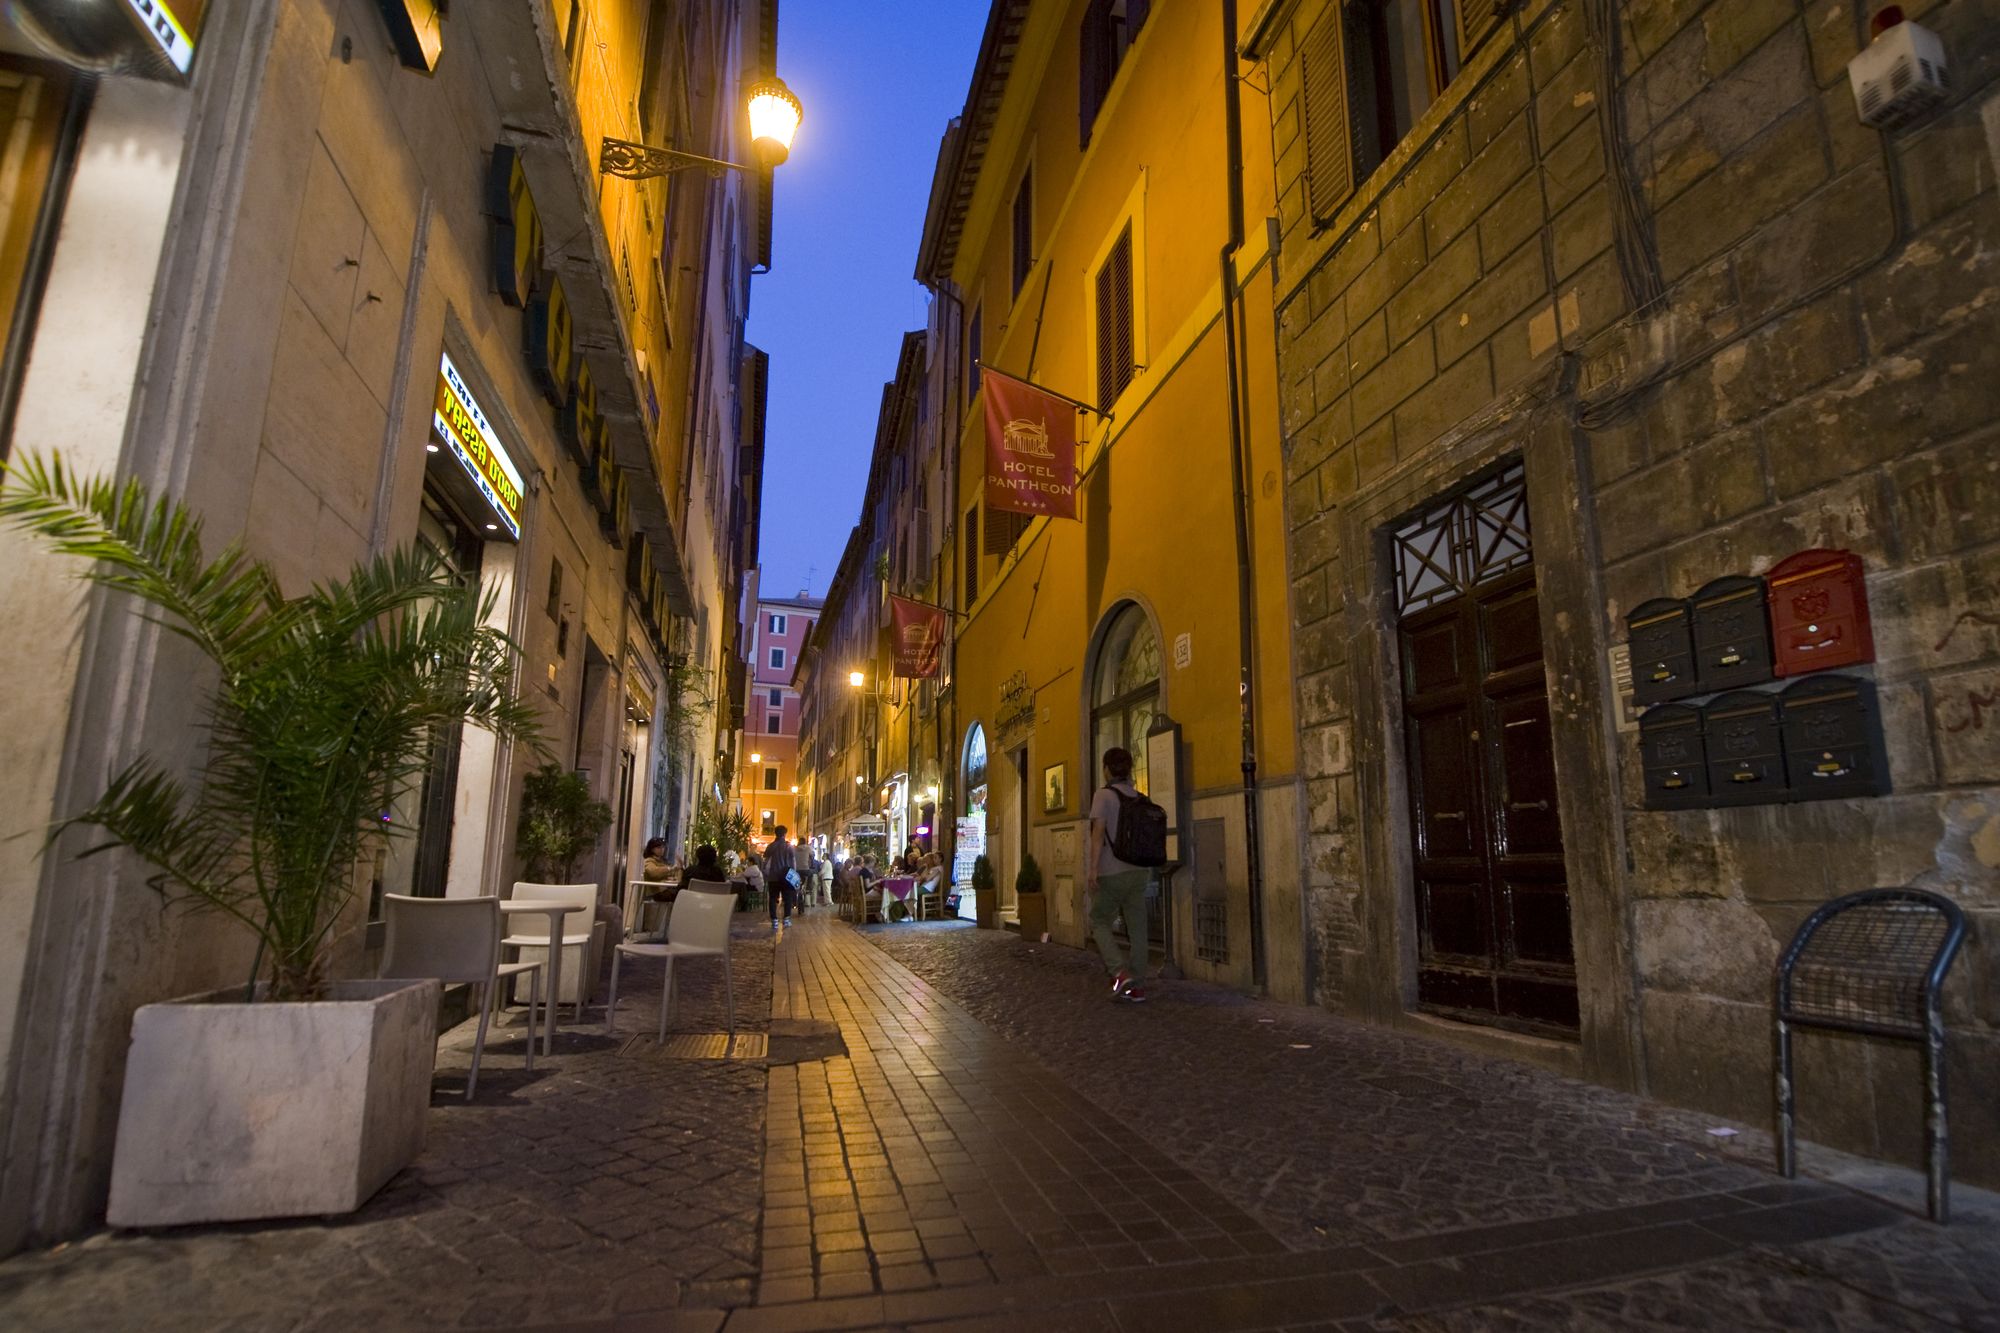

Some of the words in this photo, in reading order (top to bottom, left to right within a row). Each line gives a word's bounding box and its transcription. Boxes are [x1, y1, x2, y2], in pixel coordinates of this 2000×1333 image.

[439, 420, 450, 443] EL
[481, 477, 494, 502] DEL
[1004, 461, 1055, 478] HOTEL
[988, 475, 1072, 496] PANTHEON
